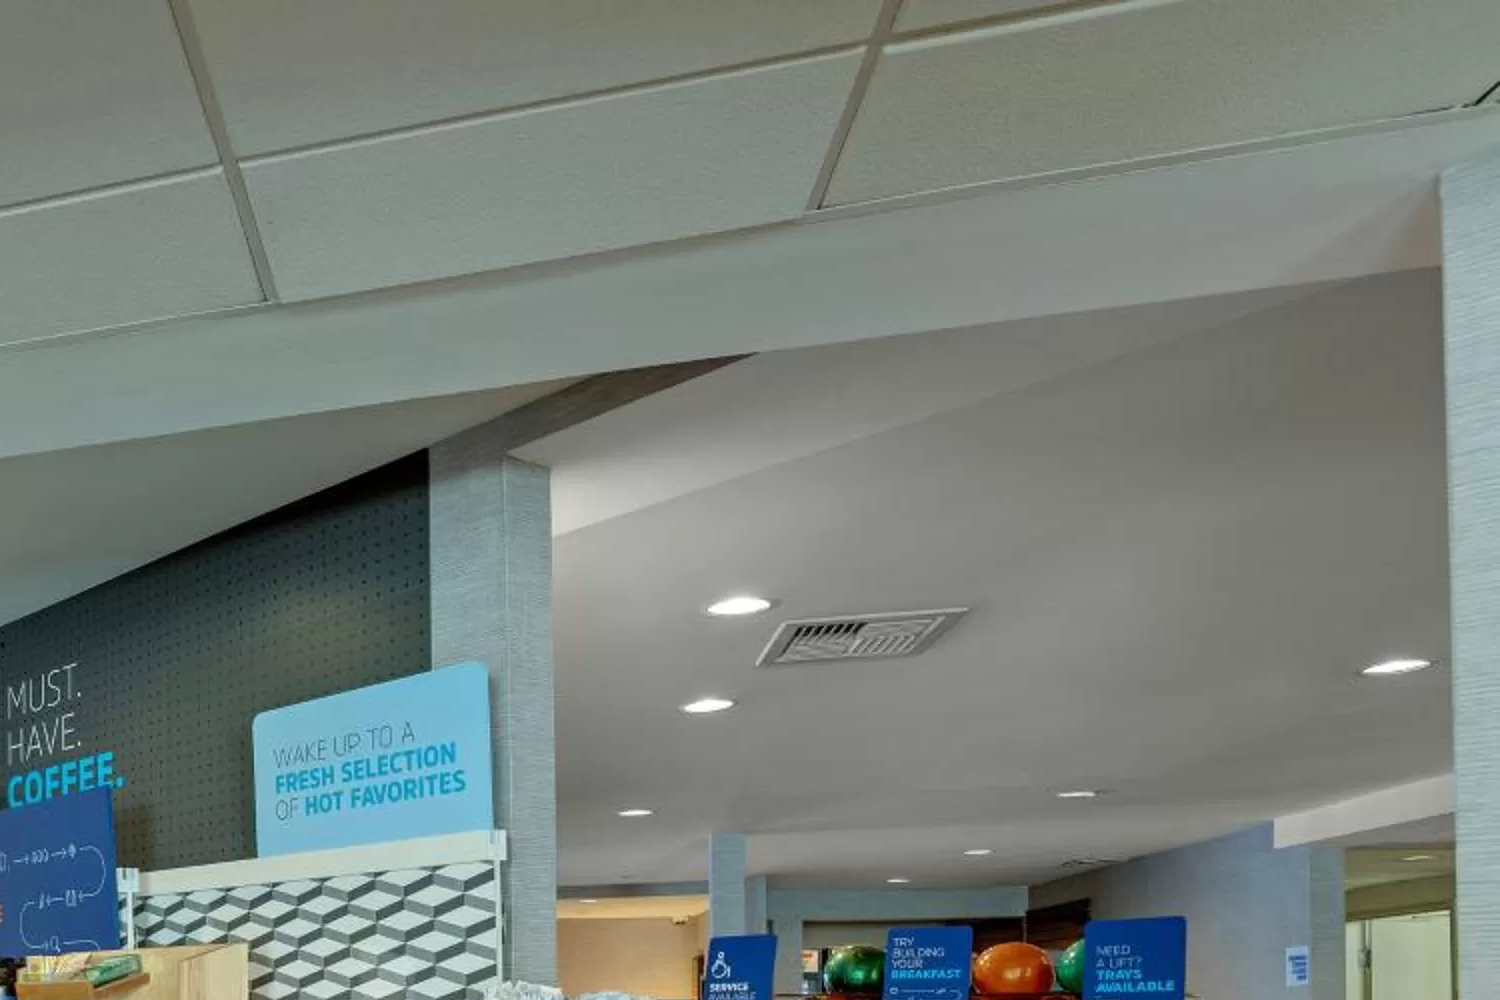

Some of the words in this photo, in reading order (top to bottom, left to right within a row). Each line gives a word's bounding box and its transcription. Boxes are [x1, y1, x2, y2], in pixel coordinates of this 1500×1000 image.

[7, 663, 81, 720] MUST.
[7, 712, 81, 766] HAVE.
[273, 739, 328, 768] WAKE
[333, 732, 361, 757] UP
[366, 725, 393, 749] TO
[401, 721, 416, 743] A
[275, 765, 335, 794] FRESH
[341, 741, 457, 783] SELECTION
[7, 752, 125, 809] COFFEE.
[275, 798, 299, 821] OF
[305, 790, 345, 816] HOT
[351, 770, 467, 808] FAVORITES
[892, 936, 915, 946] TRY
[1095, 944, 1131, 956] NEED
[891, 959, 923, 969] YOUR
[891, 969, 962, 979] BREAKFAST
[1096, 969, 1142, 980] TRAYS
[709, 982, 749, 992] SERVICE
[1095, 980, 1176, 993] AVAILABLE
